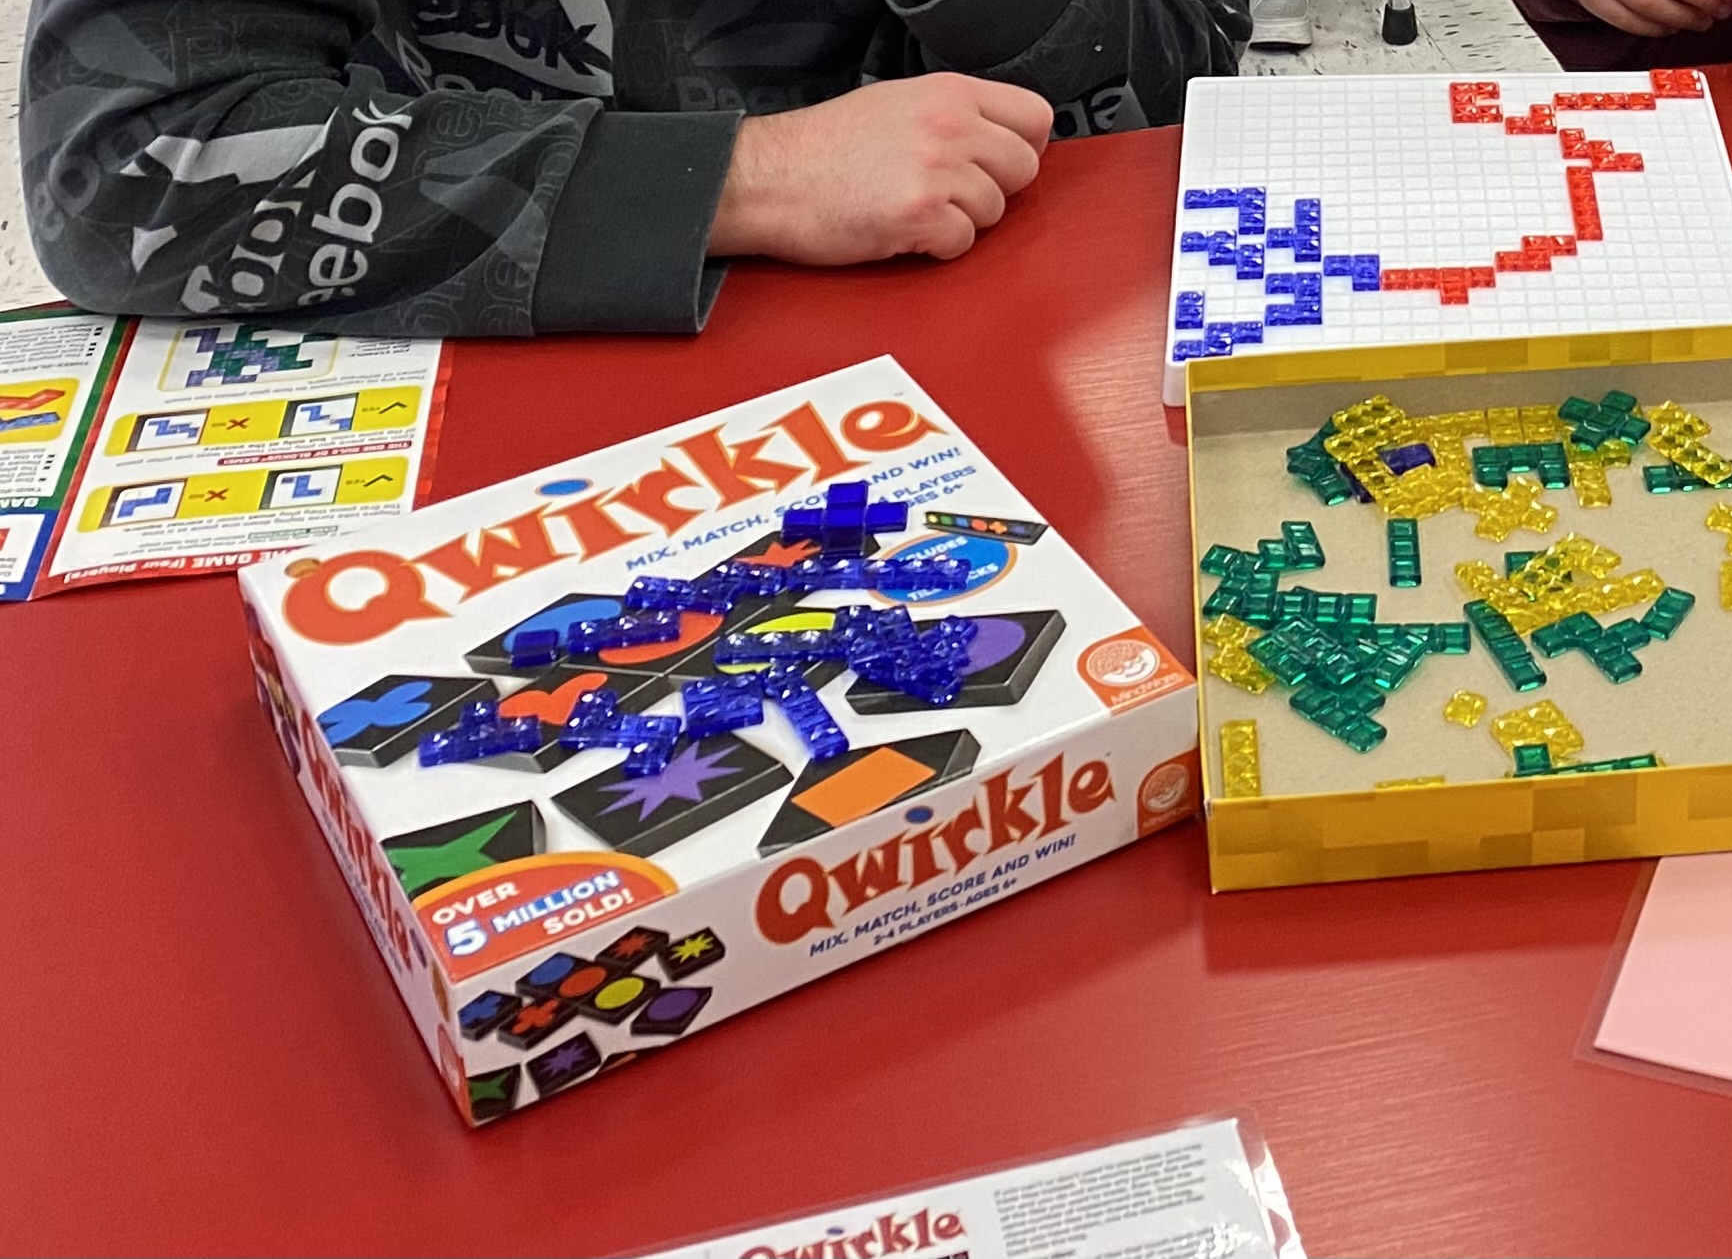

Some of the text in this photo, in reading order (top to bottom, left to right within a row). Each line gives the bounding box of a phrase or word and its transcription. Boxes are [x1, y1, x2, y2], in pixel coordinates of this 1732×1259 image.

[282, 400, 946, 644] Qwirkle
[626, 548, 677, 571] MIX,
[683, 512, 769, 551] MATCH,
[909, 446, 962, 470] WIN!
[893, 465, 976, 499] PLAYERS
[192, 553, 252, 568] GAME
[755, 752, 1116, 945] Qwirkle
[854, 902, 921, 939] MATCH,
[926, 875, 985, 906] SCORE
[992, 854, 1028, 879] AND
[1036, 834, 1076, 860] WIN!
[431, 881, 519, 925] OVER
[445, 869, 620, 956] 5 MILLION
[542, 888, 634, 935] SOLD!
